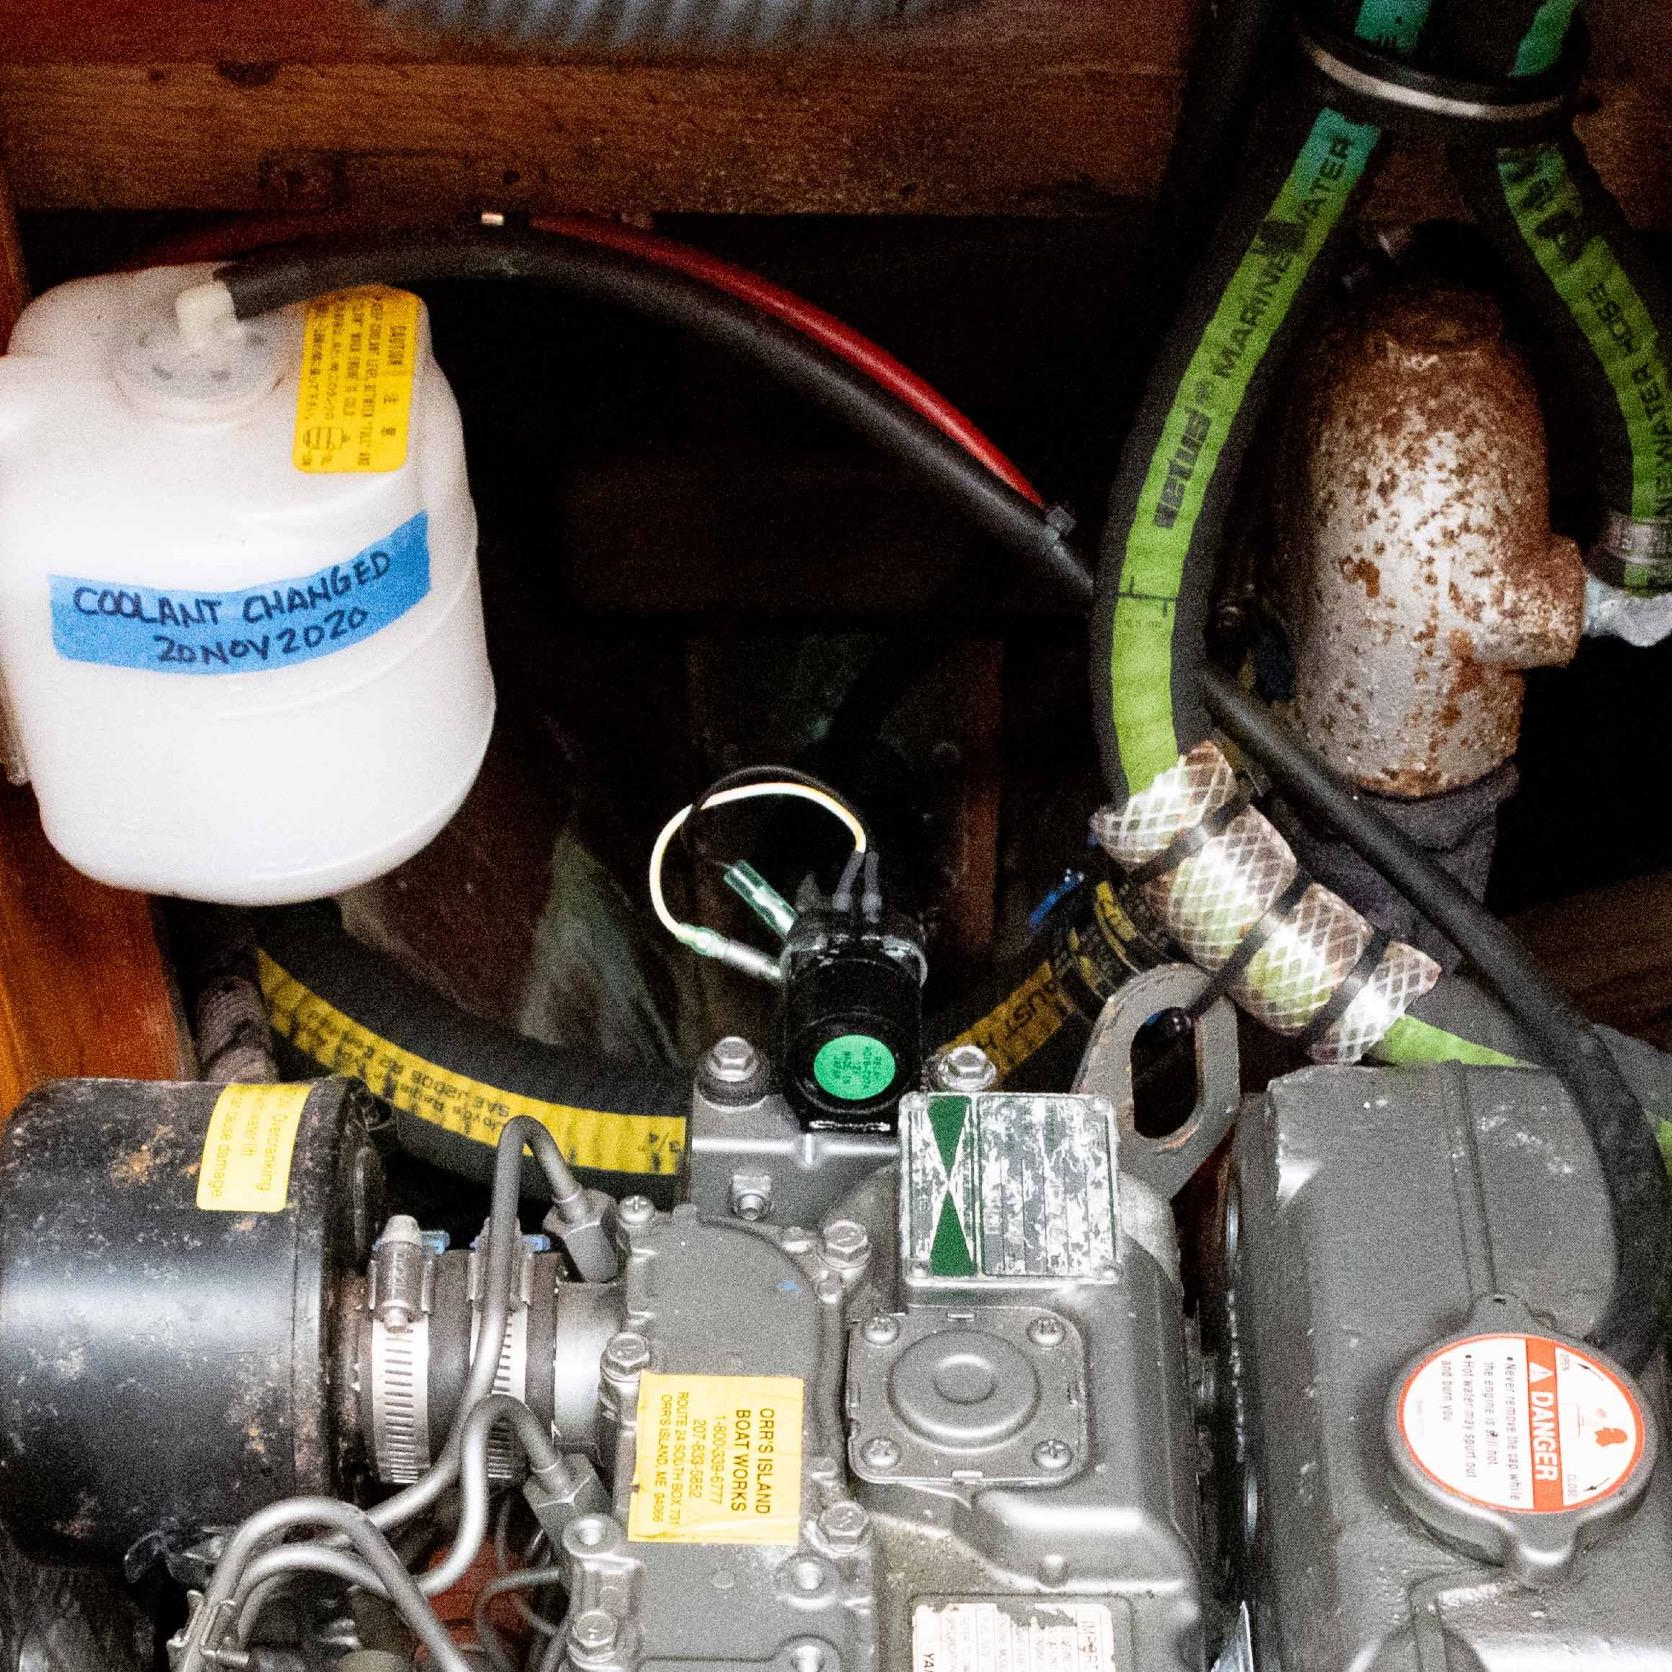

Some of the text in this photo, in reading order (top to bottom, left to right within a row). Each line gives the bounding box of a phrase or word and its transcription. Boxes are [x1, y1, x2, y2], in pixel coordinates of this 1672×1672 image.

[1212, 252, 1294, 377] MARINE
[73, 550, 391, 628] COOLANT CHANGED
[208, 1144, 230, 1198] damage
[1441, 1361, 1455, 1378] and
[1484, 1362, 1496, 1377] the
[1442, 1380, 1455, 1401] burn
[1464, 1380, 1476, 1407] water
[1481, 1380, 1496, 1415] engine
[660, 1393, 673, 1425] ORR'S
[676, 1392, 689, 1427] ROUTE
[1461, 1410, 1475, 1430] may
[1485, 1418, 1497, 1426] is
[675, 1430, 686, 1441] 24
[1463, 1433, 1477, 1459] spurt
[1504, 1364, 1522, 1501] Never remove the cap while
[1530, 1391, 1558, 1481] DANGER
[672, 1445, 685, 1481] SOUTH
[731, 1409, 751, 1512] BOAT WORKS
[755, 1408, 775, 1515] ORR'S ISLAND
[1465, 1462, 1477, 1478] out
[655, 1471, 666, 1487] ME
[670, 1483, 683, 1506] BOX
